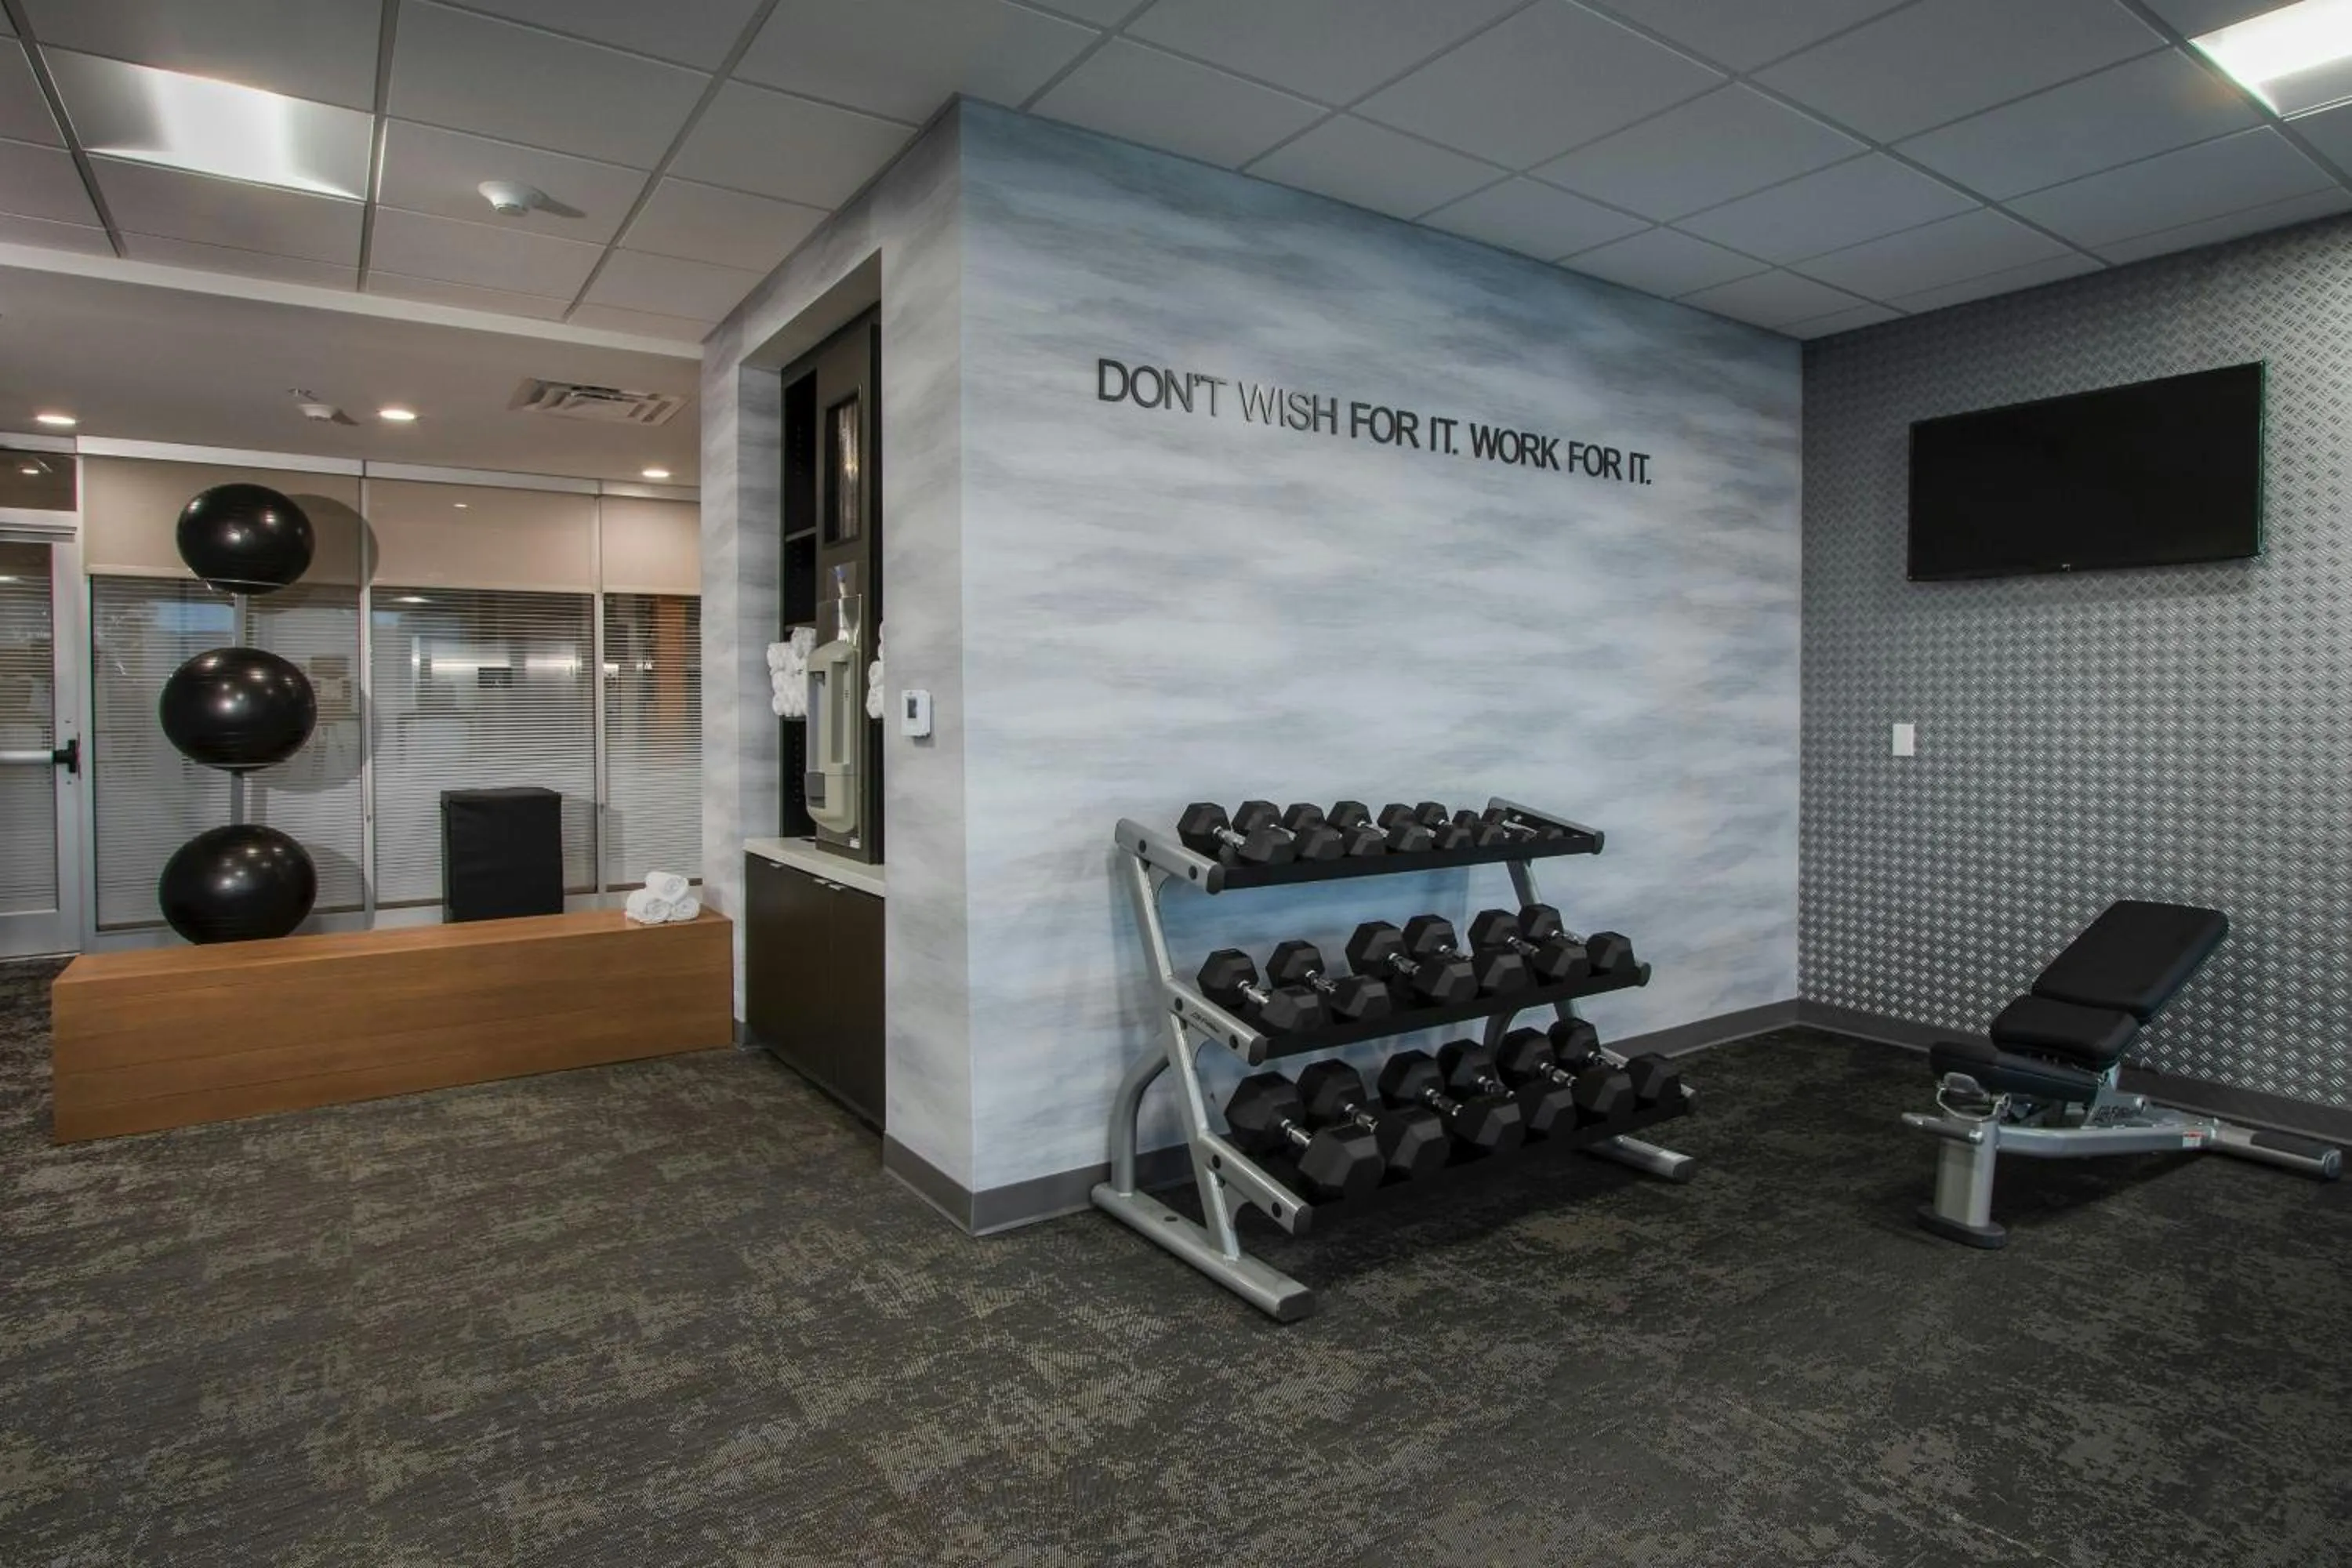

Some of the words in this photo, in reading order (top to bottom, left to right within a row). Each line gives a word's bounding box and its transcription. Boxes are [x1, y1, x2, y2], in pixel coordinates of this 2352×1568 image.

[1098, 358, 1228, 416] DON'T
[1238, 381, 1338, 435] WISH
[1351, 401, 1420, 449] FOR
[1431, 416, 1458, 456] IT.
[1470, 423, 1560, 470] WORK
[1569, 441, 1622, 481] FOR
[1629, 452, 1652, 485] IT.
